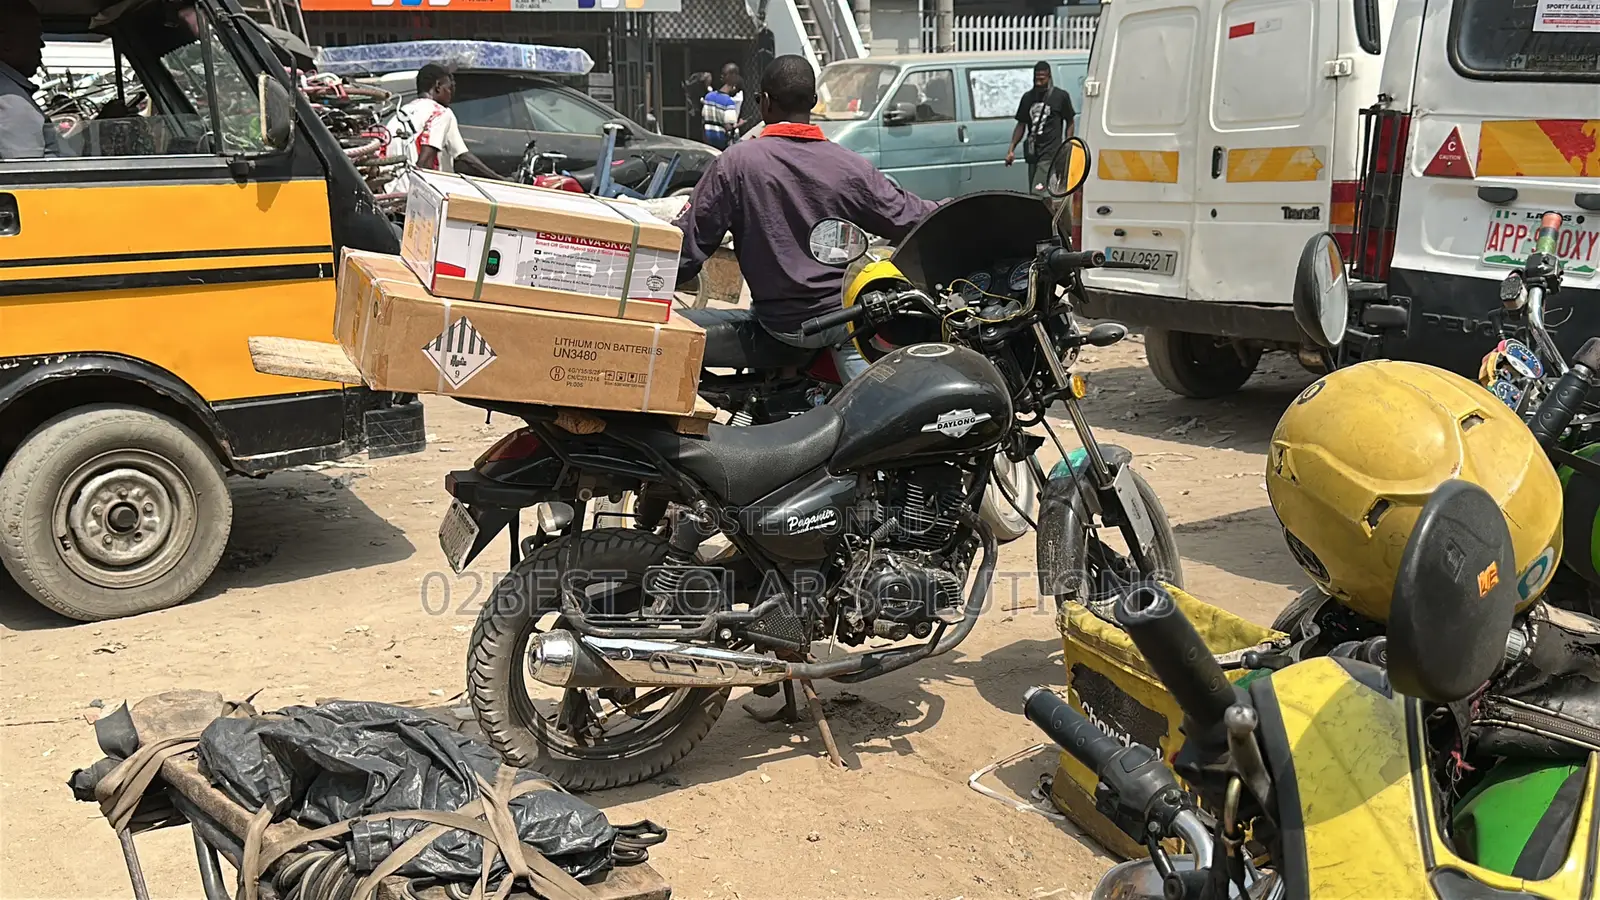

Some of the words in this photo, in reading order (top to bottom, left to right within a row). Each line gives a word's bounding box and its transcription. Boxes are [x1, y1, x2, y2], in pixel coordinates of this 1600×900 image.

[1447, 141, 1457, 152] C
[1281, 205, 1321, 221] Transit
[1163, 253, 1174, 272] T
[554, 337, 593, 349] LITHIUM
[594, 341, 612, 351] ION
[613, 343, 663, 356] BATTERIES
[553, 347, 598, 361] UN3480
[455, 370, 460, 378] 9
[937, 417, 976, 430] DAYLONG
